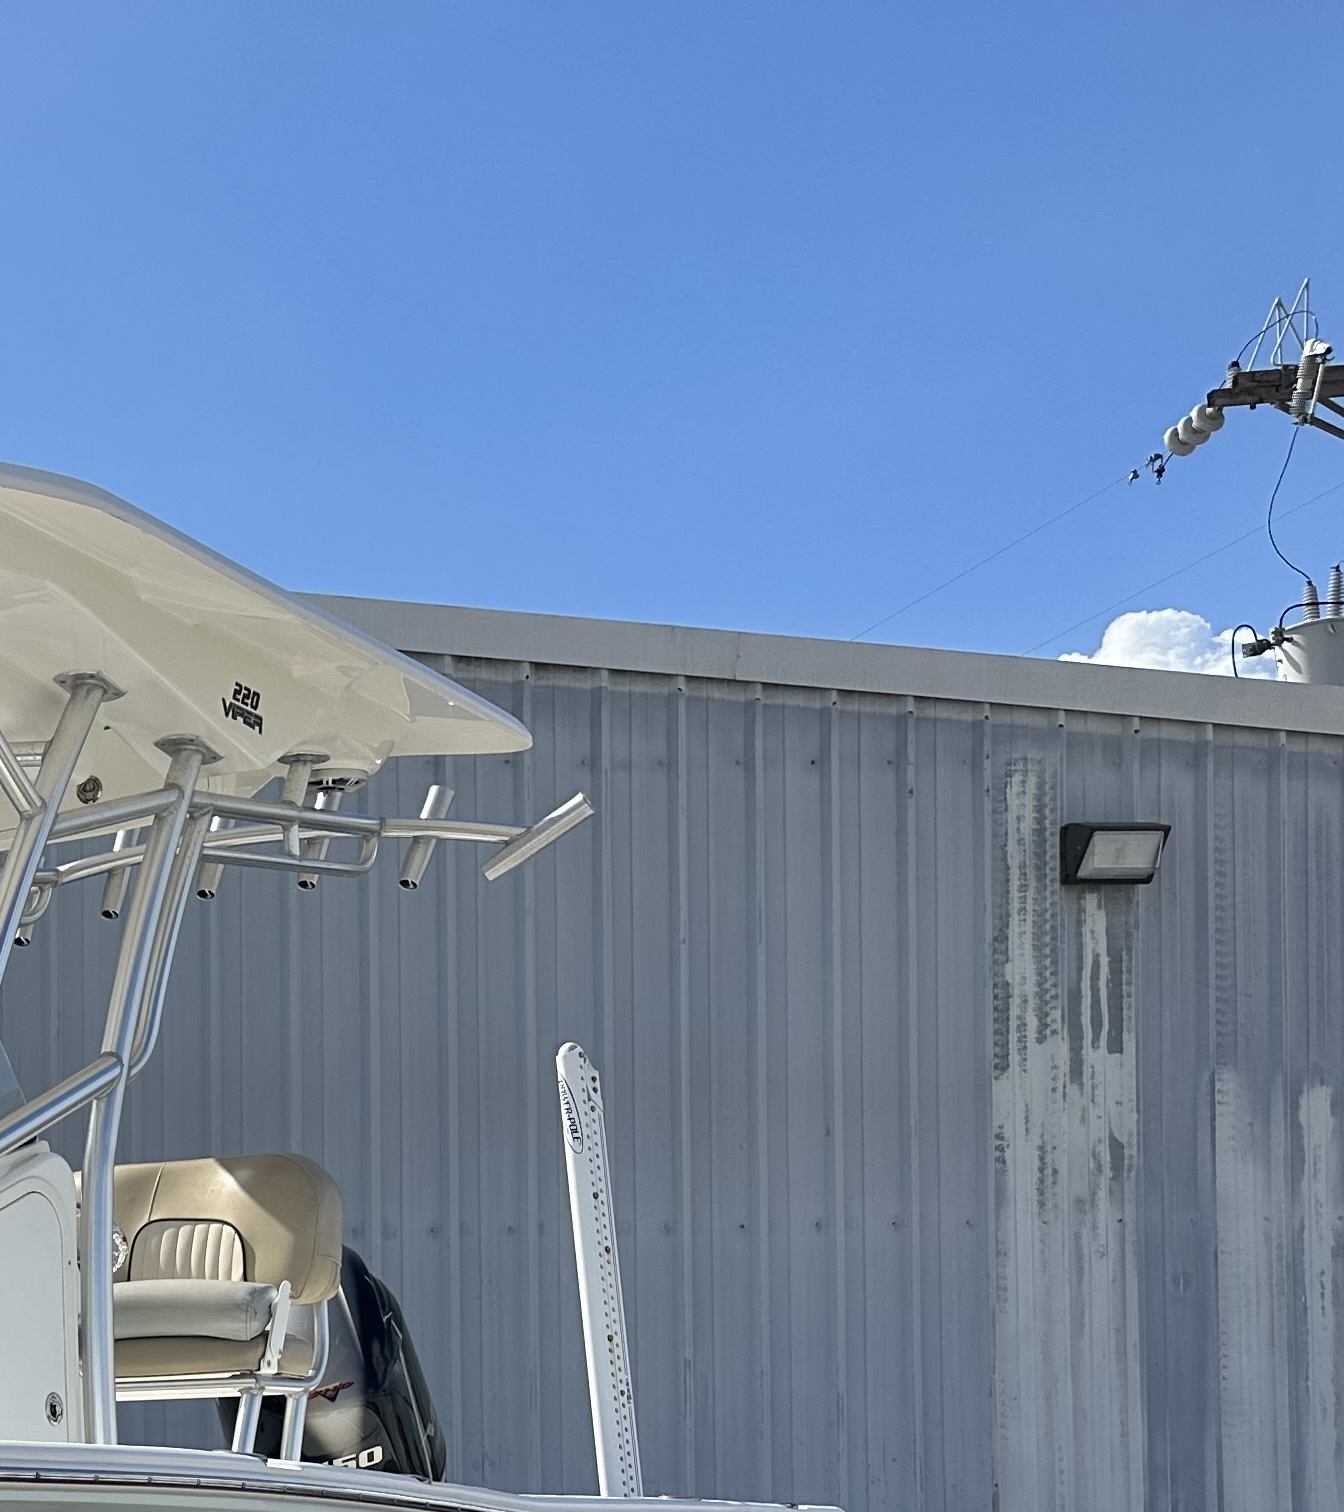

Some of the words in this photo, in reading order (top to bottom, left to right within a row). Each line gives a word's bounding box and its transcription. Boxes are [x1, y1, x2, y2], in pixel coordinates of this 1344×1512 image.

[232, 681, 261, 711] 220
[221, 697, 263, 735] VIPER
[322, 1445, 383, 1469] 50
